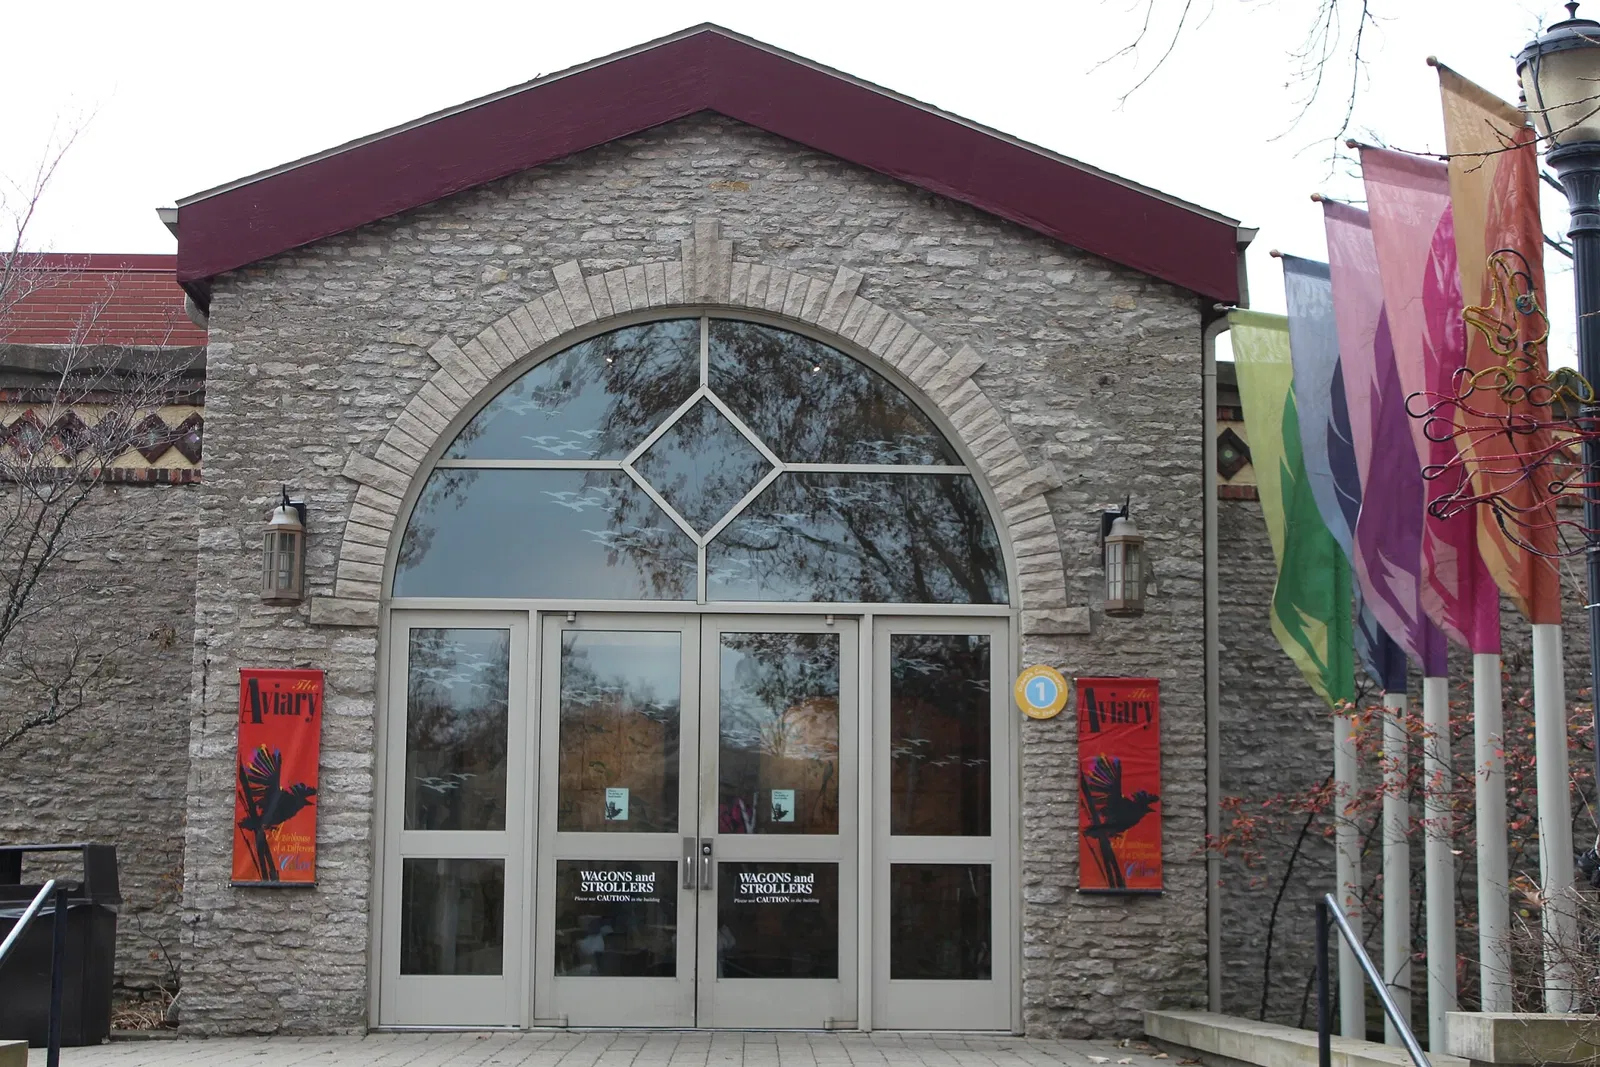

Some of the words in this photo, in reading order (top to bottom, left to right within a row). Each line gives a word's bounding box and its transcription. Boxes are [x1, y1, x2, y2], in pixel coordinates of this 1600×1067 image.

[291, 679, 319, 691] The
[1035, 682, 1045, 701] 1
[1127, 688, 1153, 699] The
[241, 678, 319, 724] Aviary
[1080, 687, 1155, 733] Aviary
[580, 871, 632, 882] WAGONS
[635, 872, 656, 882] and
[739, 873, 791, 883] WAGONS
[794, 873, 815, 883] and
[580, 882, 654, 893] STROLLERS
[740, 884, 813, 894] STROLLERS
[596, 894, 631, 902] CAUTION
[756, 896, 790, 904] CAUTION
